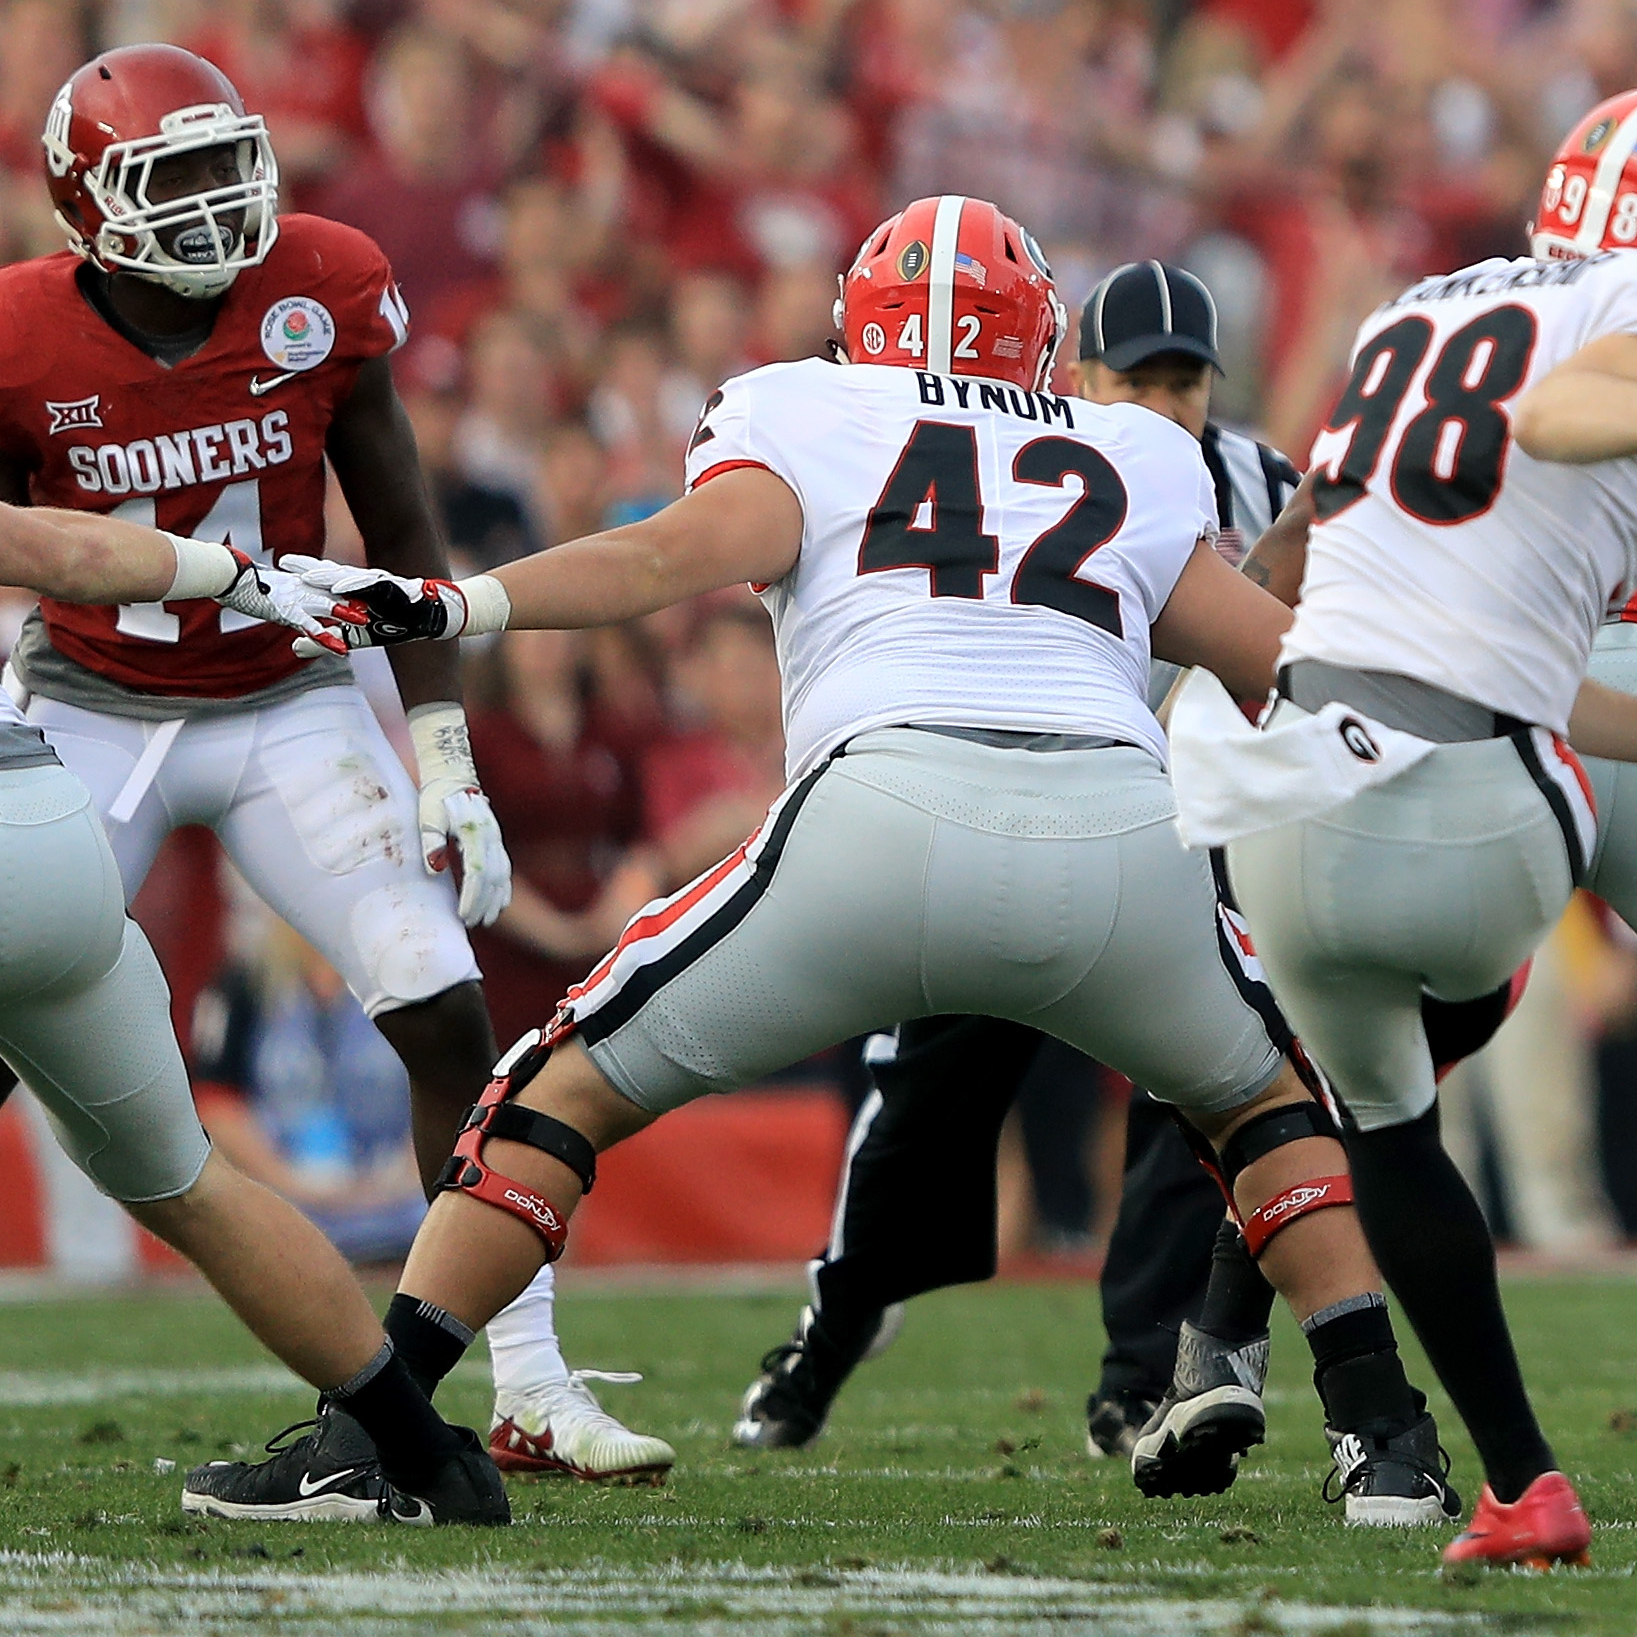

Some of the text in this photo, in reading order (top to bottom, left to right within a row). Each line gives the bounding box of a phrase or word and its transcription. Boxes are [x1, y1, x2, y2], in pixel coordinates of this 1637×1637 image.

[865, 325, 883, 351] SEC
[915, 371, 1075, 430] BYNUM
[1311, 302, 1538, 527] 98
[68, 410, 293, 494] SOONERS
[857, 419, 1128, 640] 42
[504, 1189, 561, 1231] DONJOY
[1263, 1184, 1329, 1221] DONJOY
